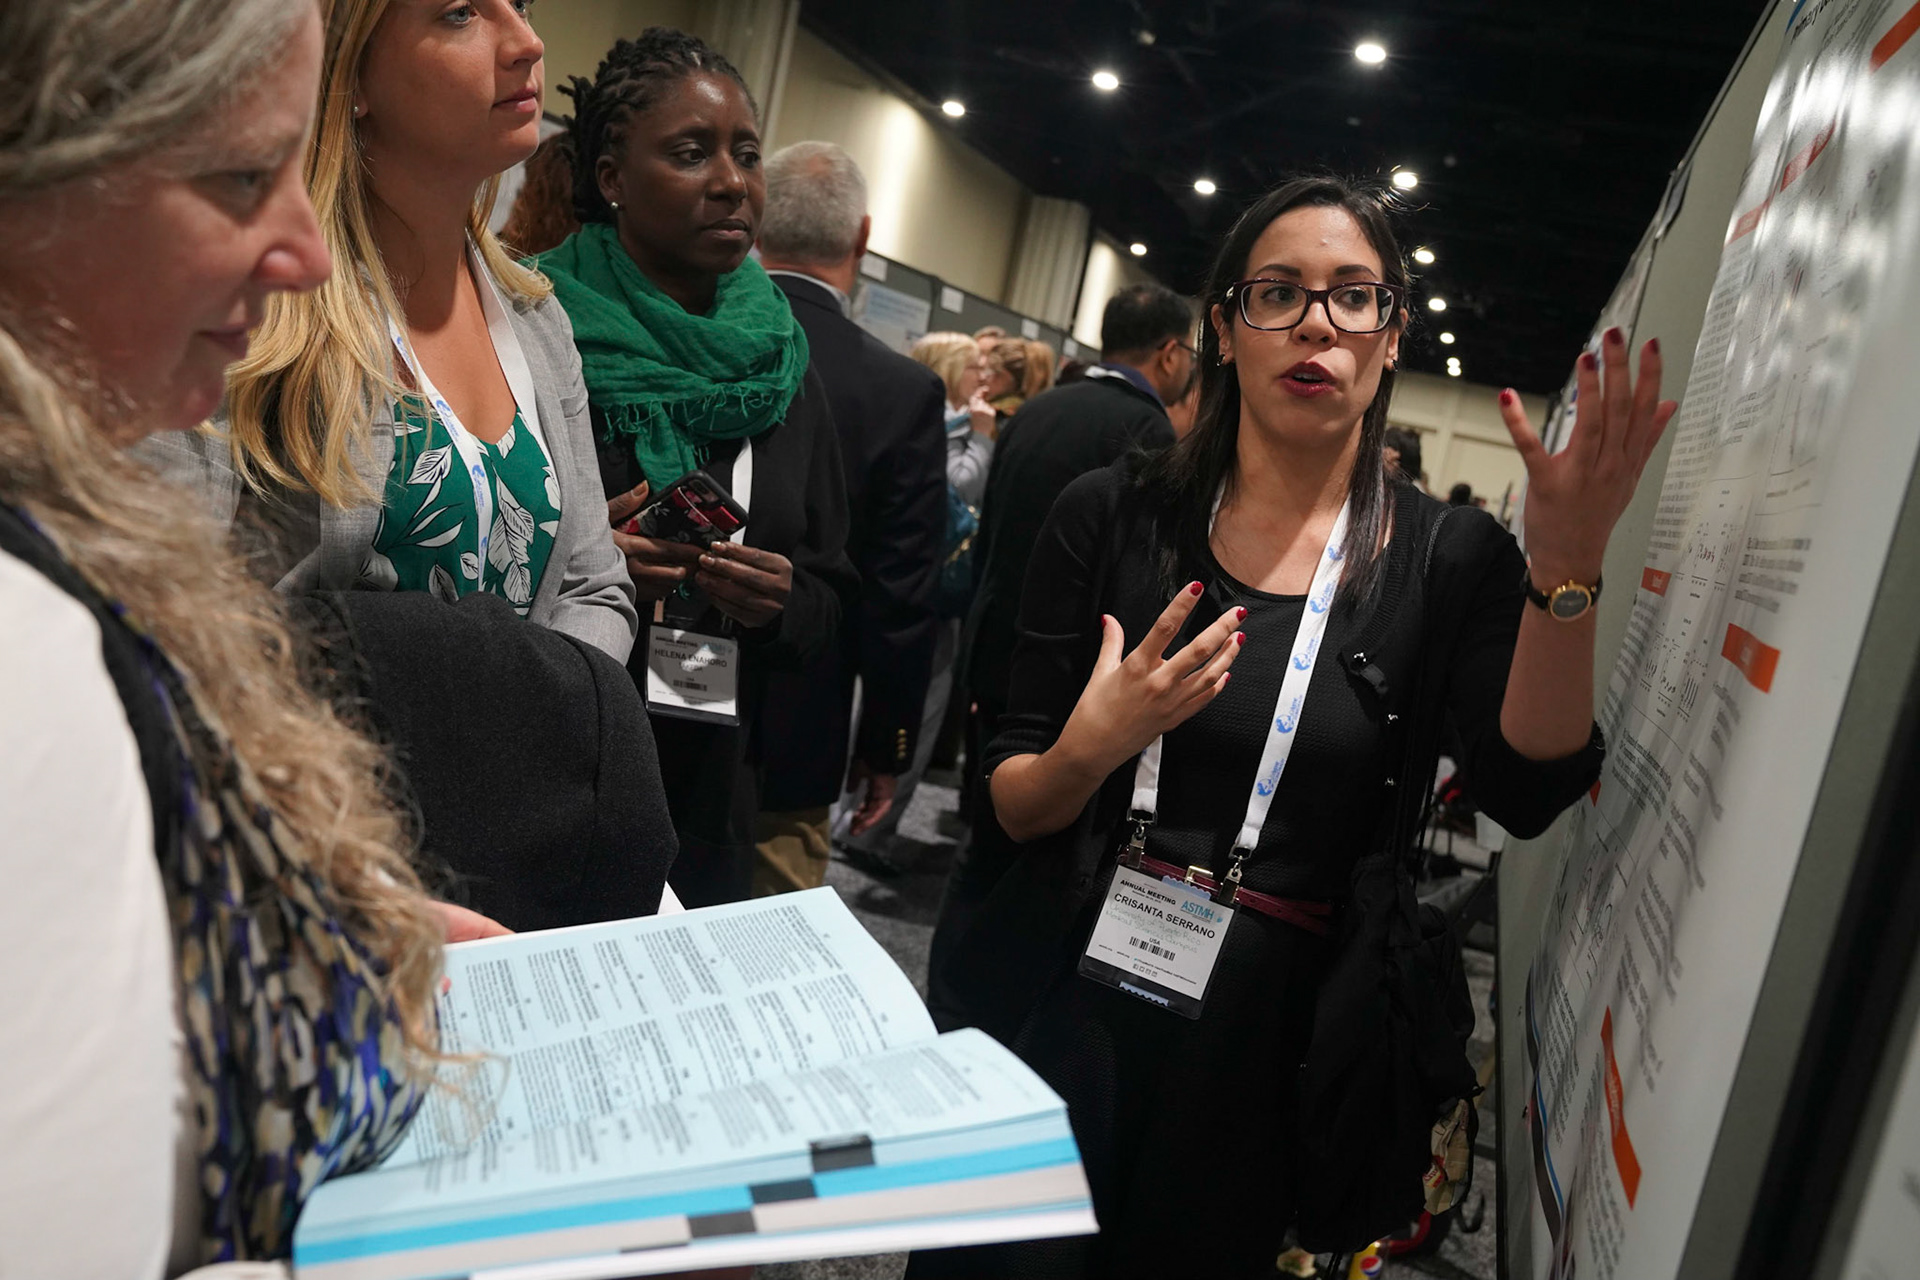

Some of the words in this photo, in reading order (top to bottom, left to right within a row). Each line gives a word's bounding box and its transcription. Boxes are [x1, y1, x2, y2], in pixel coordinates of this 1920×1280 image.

[655, 648, 686, 660] HELENA
[689, 655, 727, 668] ENAHORO
[1120, 879, 1146, 892] ANNUAL
[1147, 890, 1176, 905] MEETING
[1114, 893, 1163, 919] CRISANTA
[1165, 913, 1215, 939] SERRANO
[1181, 900, 1215, 920] ASTMH
[1149, 937, 1160, 946] USA
